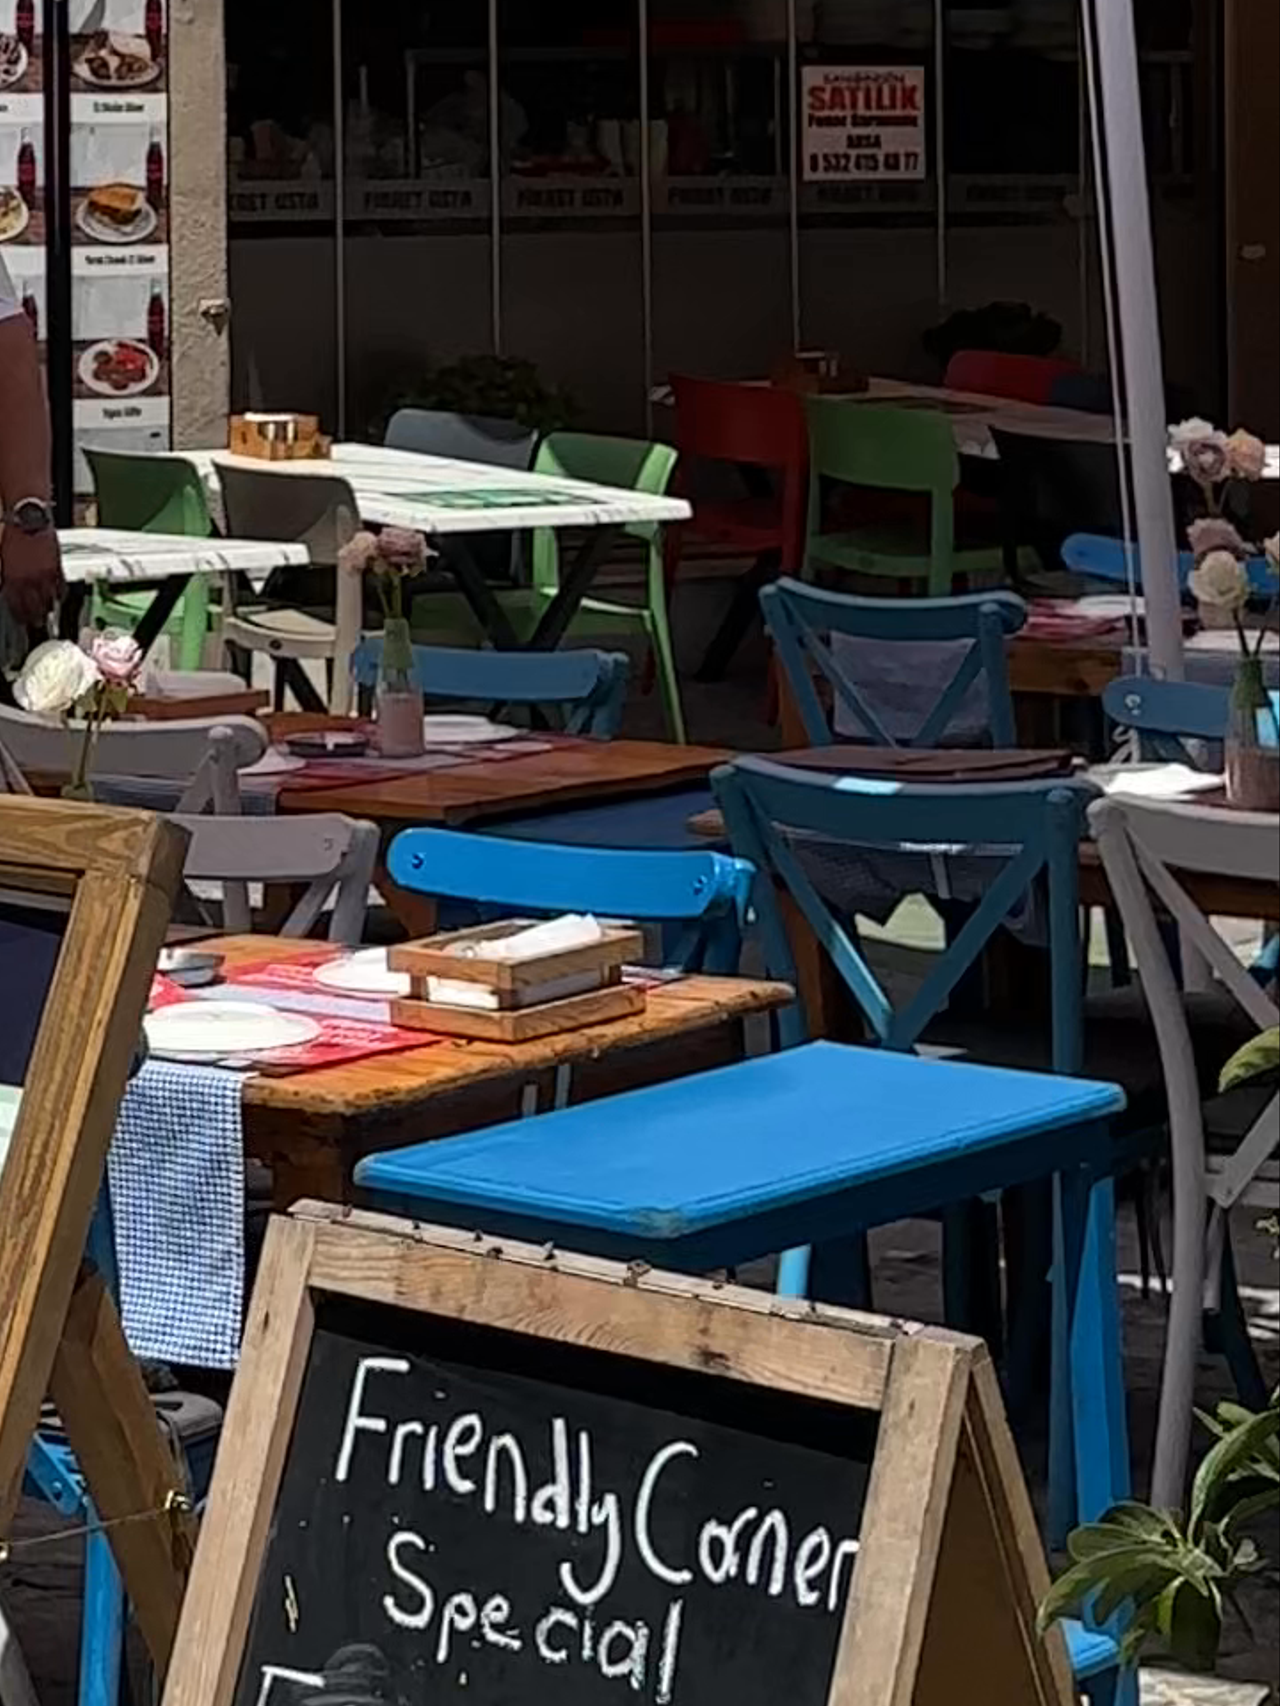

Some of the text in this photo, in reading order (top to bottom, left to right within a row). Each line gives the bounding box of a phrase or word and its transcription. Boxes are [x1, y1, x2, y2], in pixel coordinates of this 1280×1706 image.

[808, 84, 921, 111] SATILIK
[336, 1356, 860, 1614] Friendly Corner
[384, 1530, 685, 1704] Special
